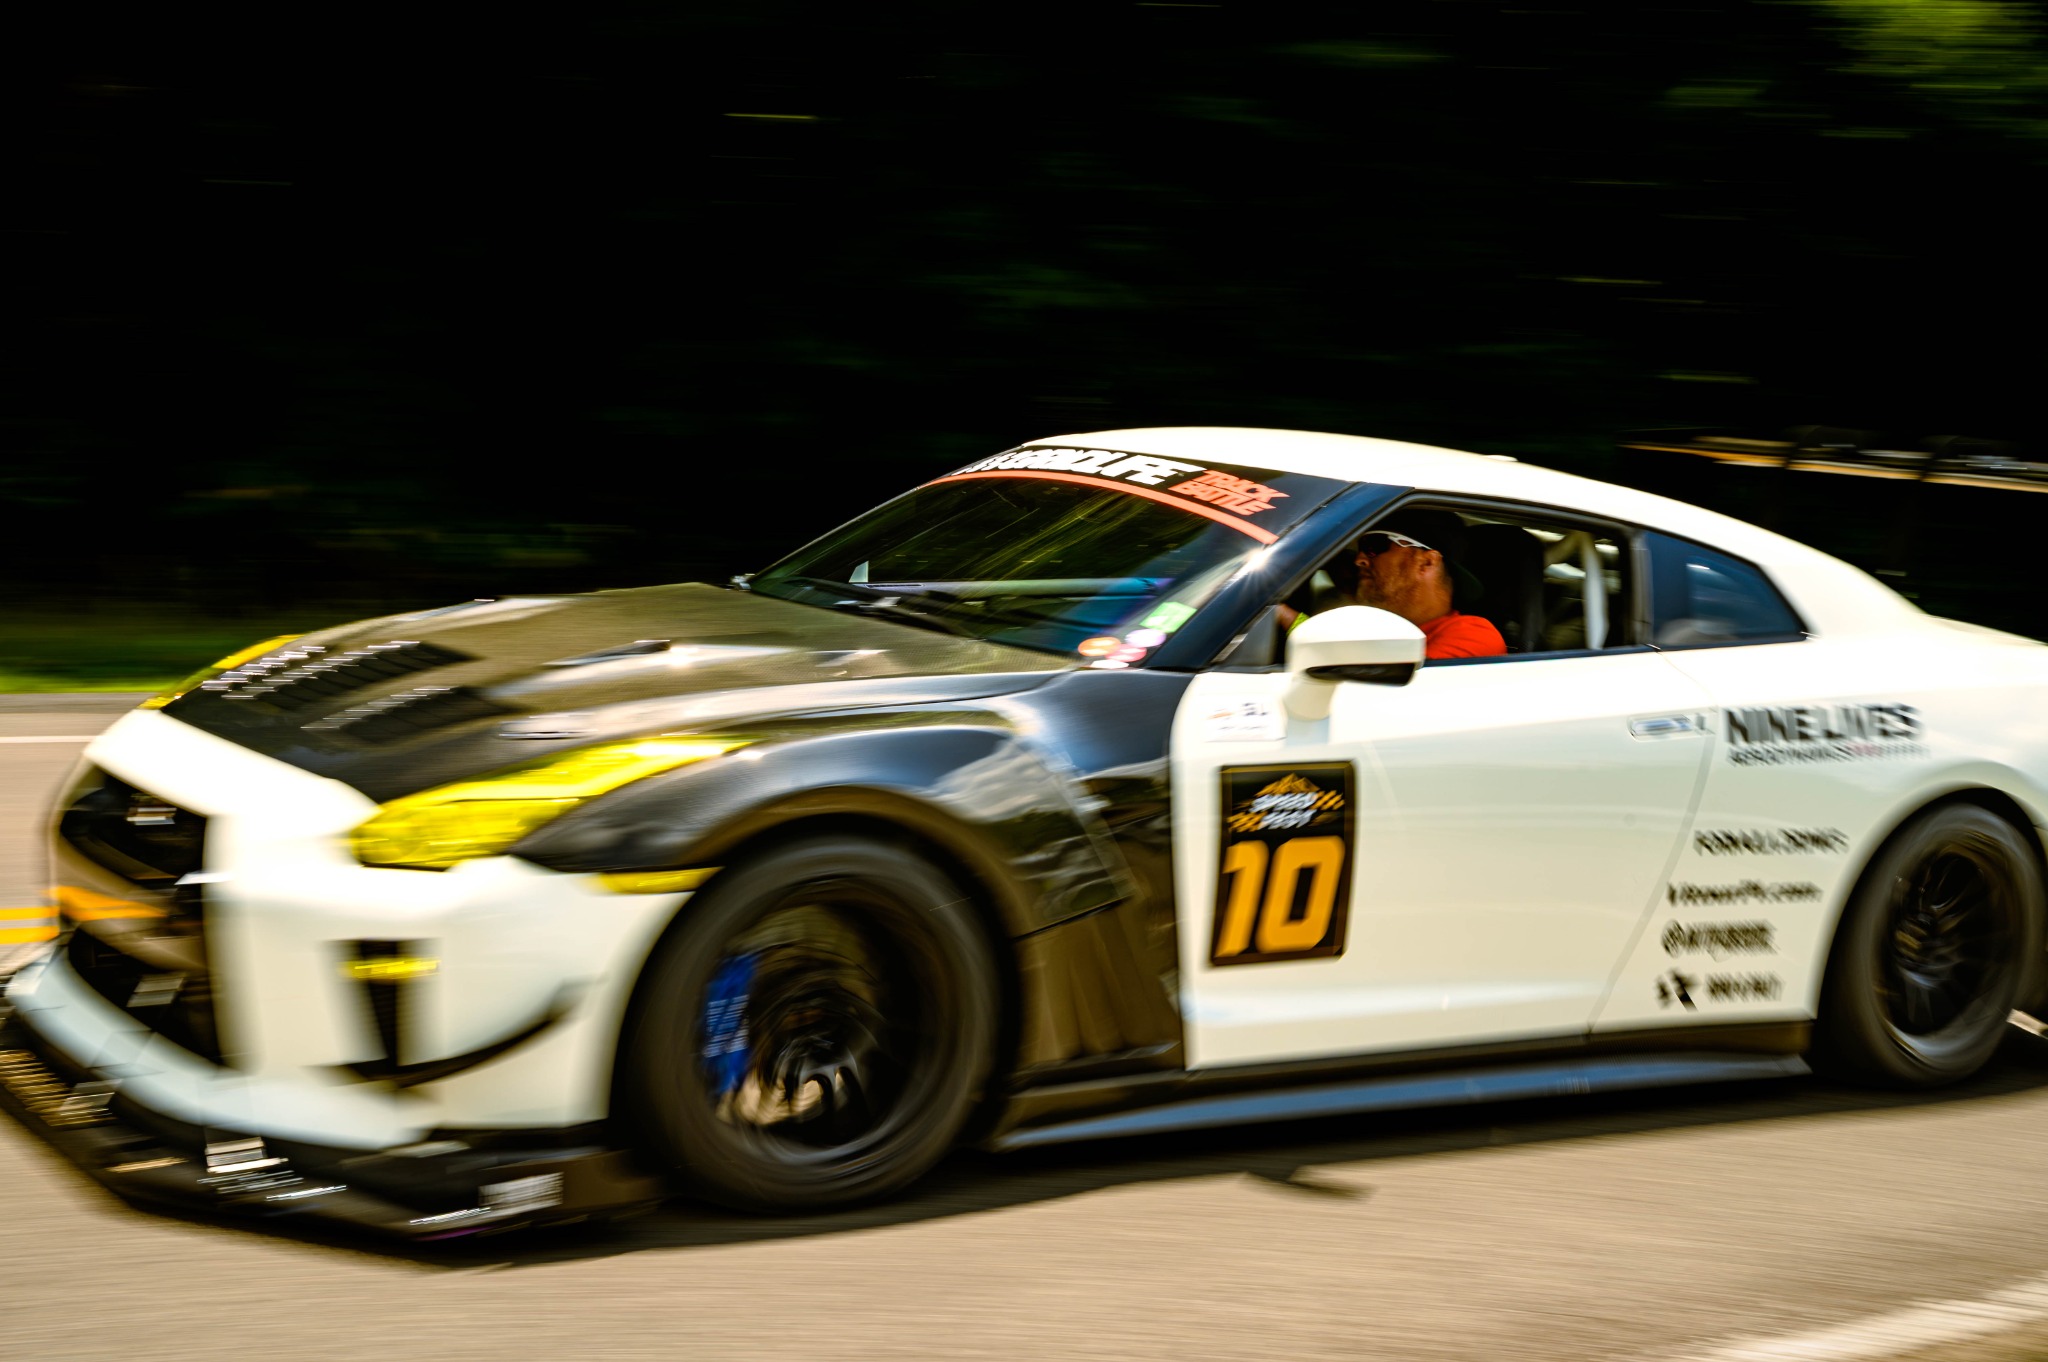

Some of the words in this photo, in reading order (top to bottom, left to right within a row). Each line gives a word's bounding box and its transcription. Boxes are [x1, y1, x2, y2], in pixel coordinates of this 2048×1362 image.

[1168, 479, 1277, 516] BATTLE
[1192, 470, 1291, 503] TRACK
[1725, 705, 1815, 742] NINE
[1816, 702, 1921, 740] LIVES
[1214, 835, 1345, 957] 10
